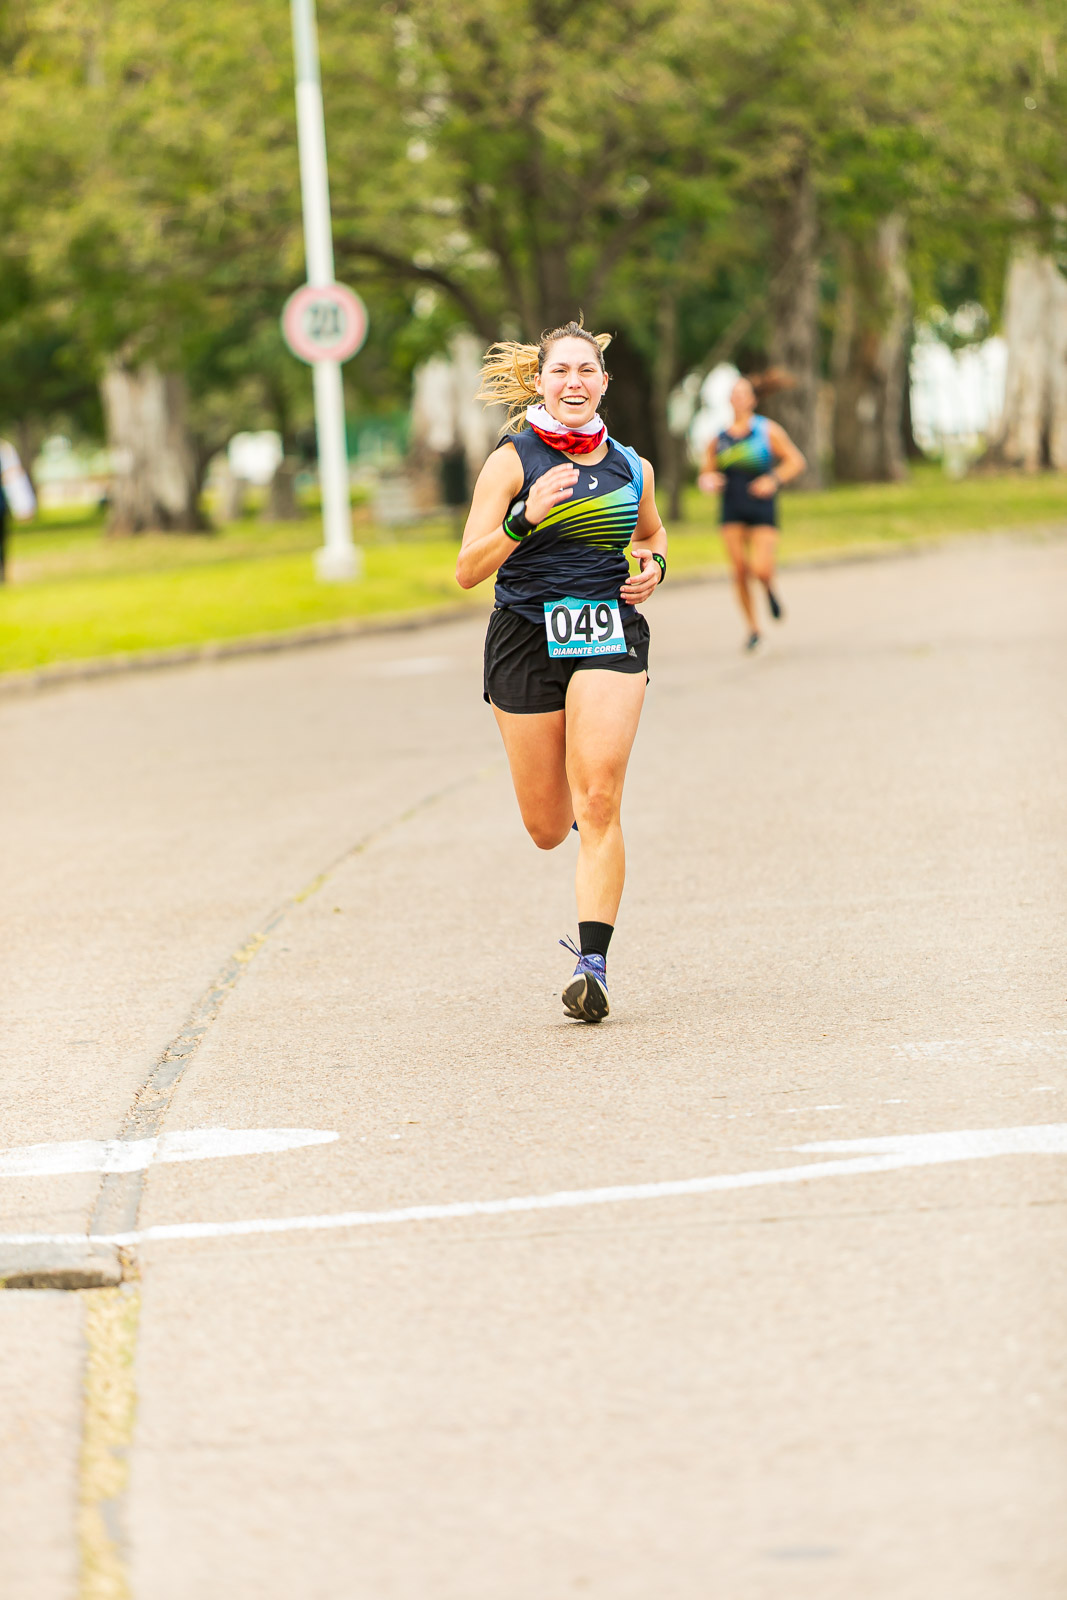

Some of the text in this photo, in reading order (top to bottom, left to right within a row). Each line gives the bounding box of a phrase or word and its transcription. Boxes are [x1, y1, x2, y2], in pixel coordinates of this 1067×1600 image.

[551, 603, 614, 645] 049
[553, 644, 621, 656] DIAMANTE CORRE
